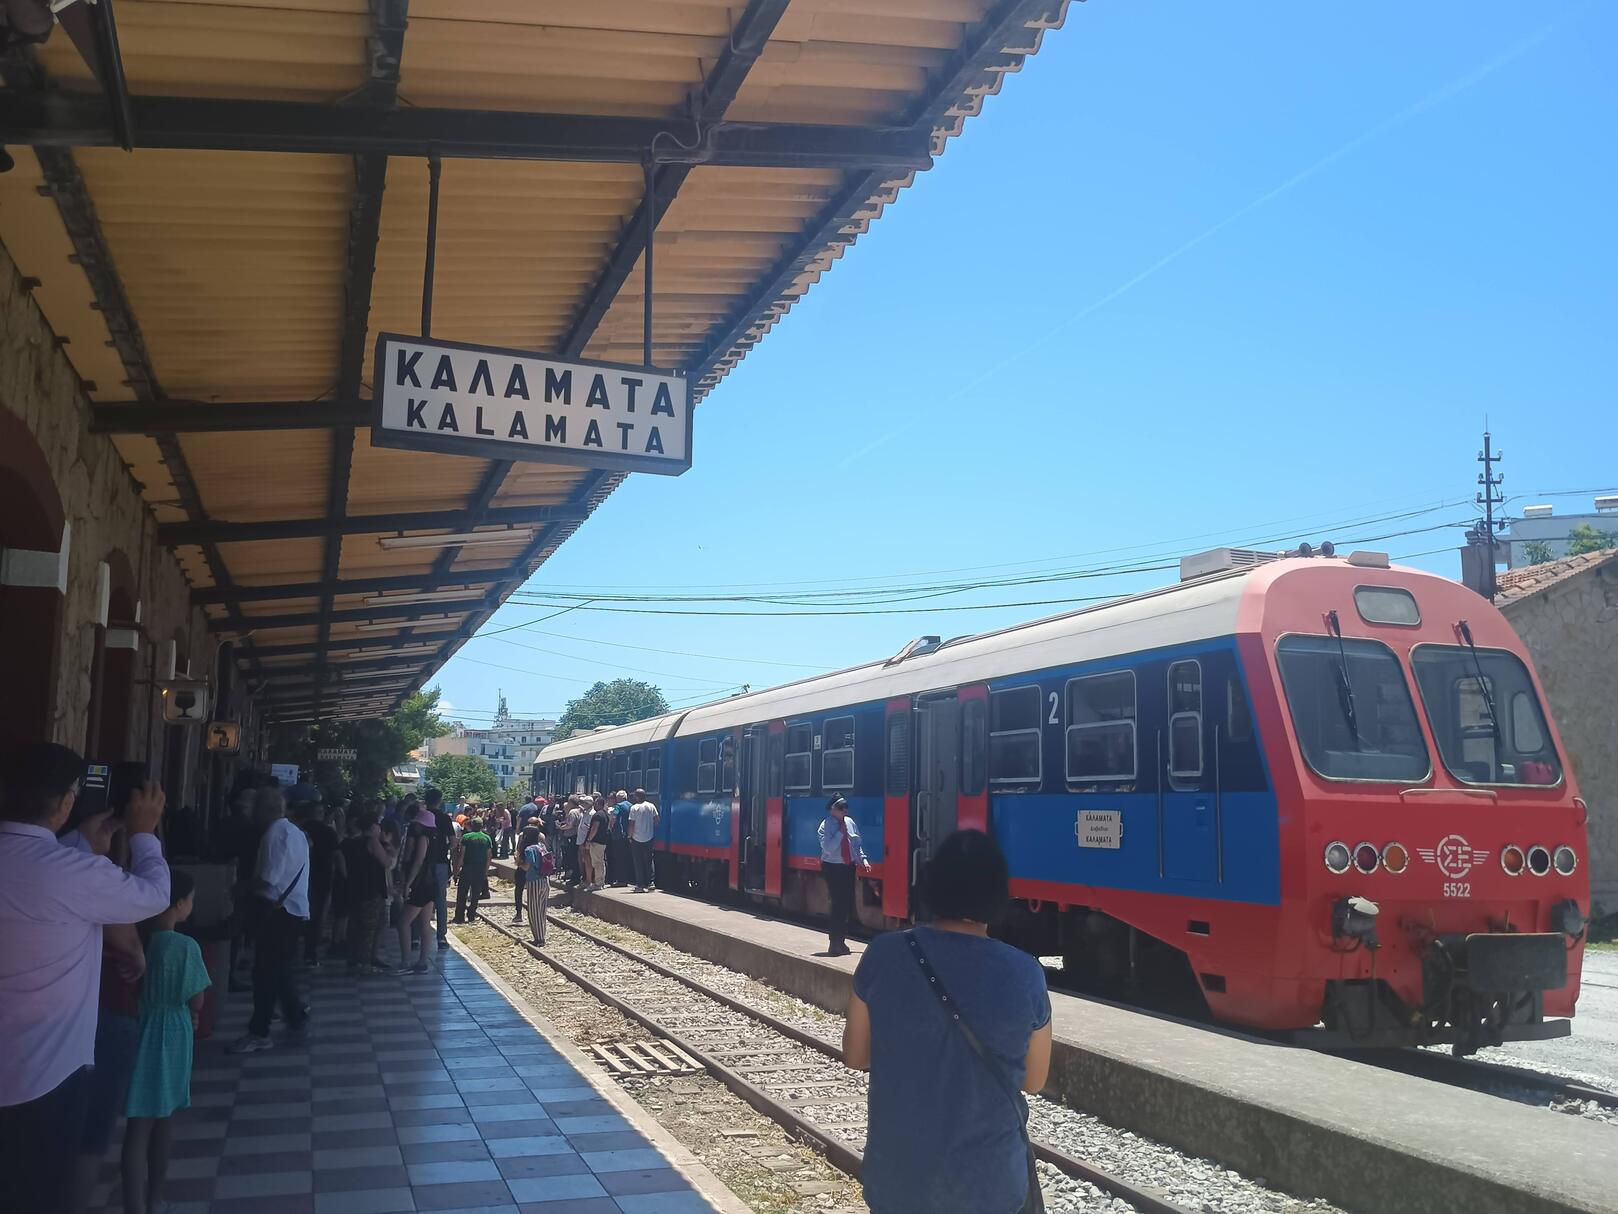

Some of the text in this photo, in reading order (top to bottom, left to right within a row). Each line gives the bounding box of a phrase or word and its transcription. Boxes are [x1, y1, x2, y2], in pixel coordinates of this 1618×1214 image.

[396, 349, 675, 418] ΚΑΛΑΜΑΤΑ
[407, 398, 664, 454] KALAMATA
[1049, 692, 1058, 724] 2
[1443, 882, 1471, 897] 5522
